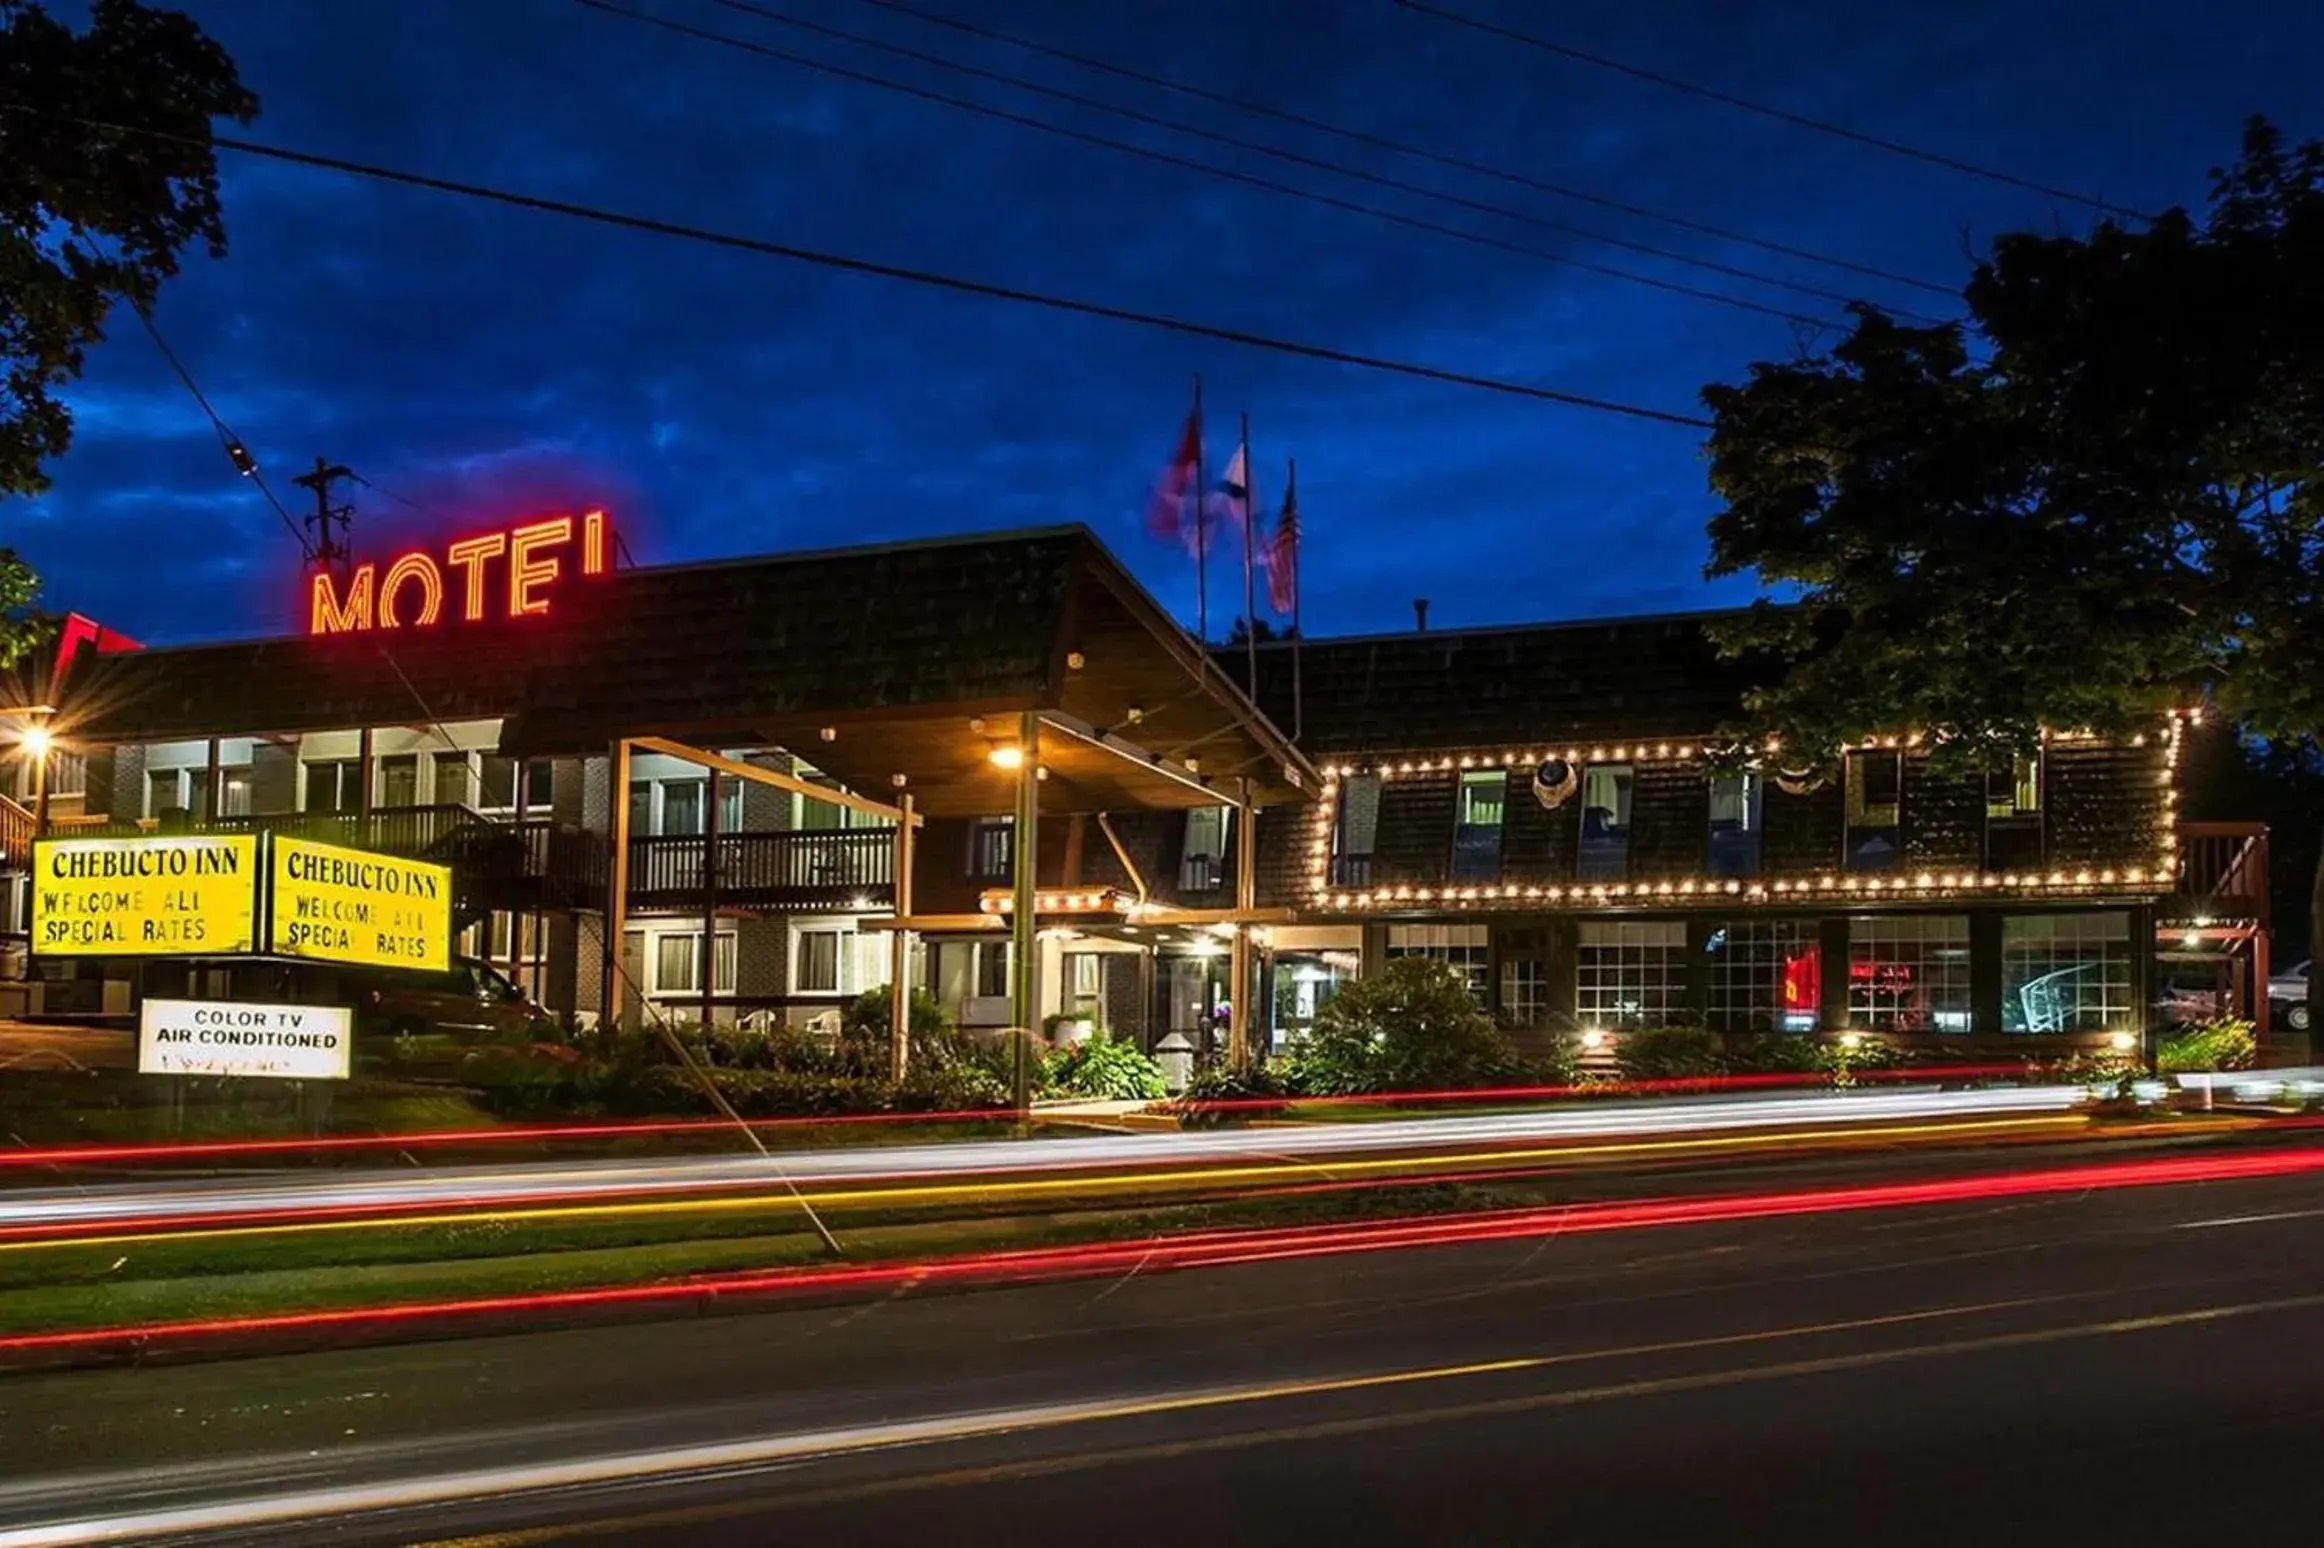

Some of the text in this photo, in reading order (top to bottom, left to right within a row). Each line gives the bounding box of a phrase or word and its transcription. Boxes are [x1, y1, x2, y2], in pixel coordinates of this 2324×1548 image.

[52, 847, 238, 878] CHEBUCTO INN
[288, 852, 437, 899] CHEBUCTO INN
[43, 890, 143, 914] WELCOME
[296, 895, 377, 925] WELCOME
[45, 918, 206, 942] SPECIAL RATES
[376, 933, 425, 958] RATES
[194, 1009, 303, 1028] COLOR TV
[156, 1028, 338, 1048] AIR CONDITIONED
